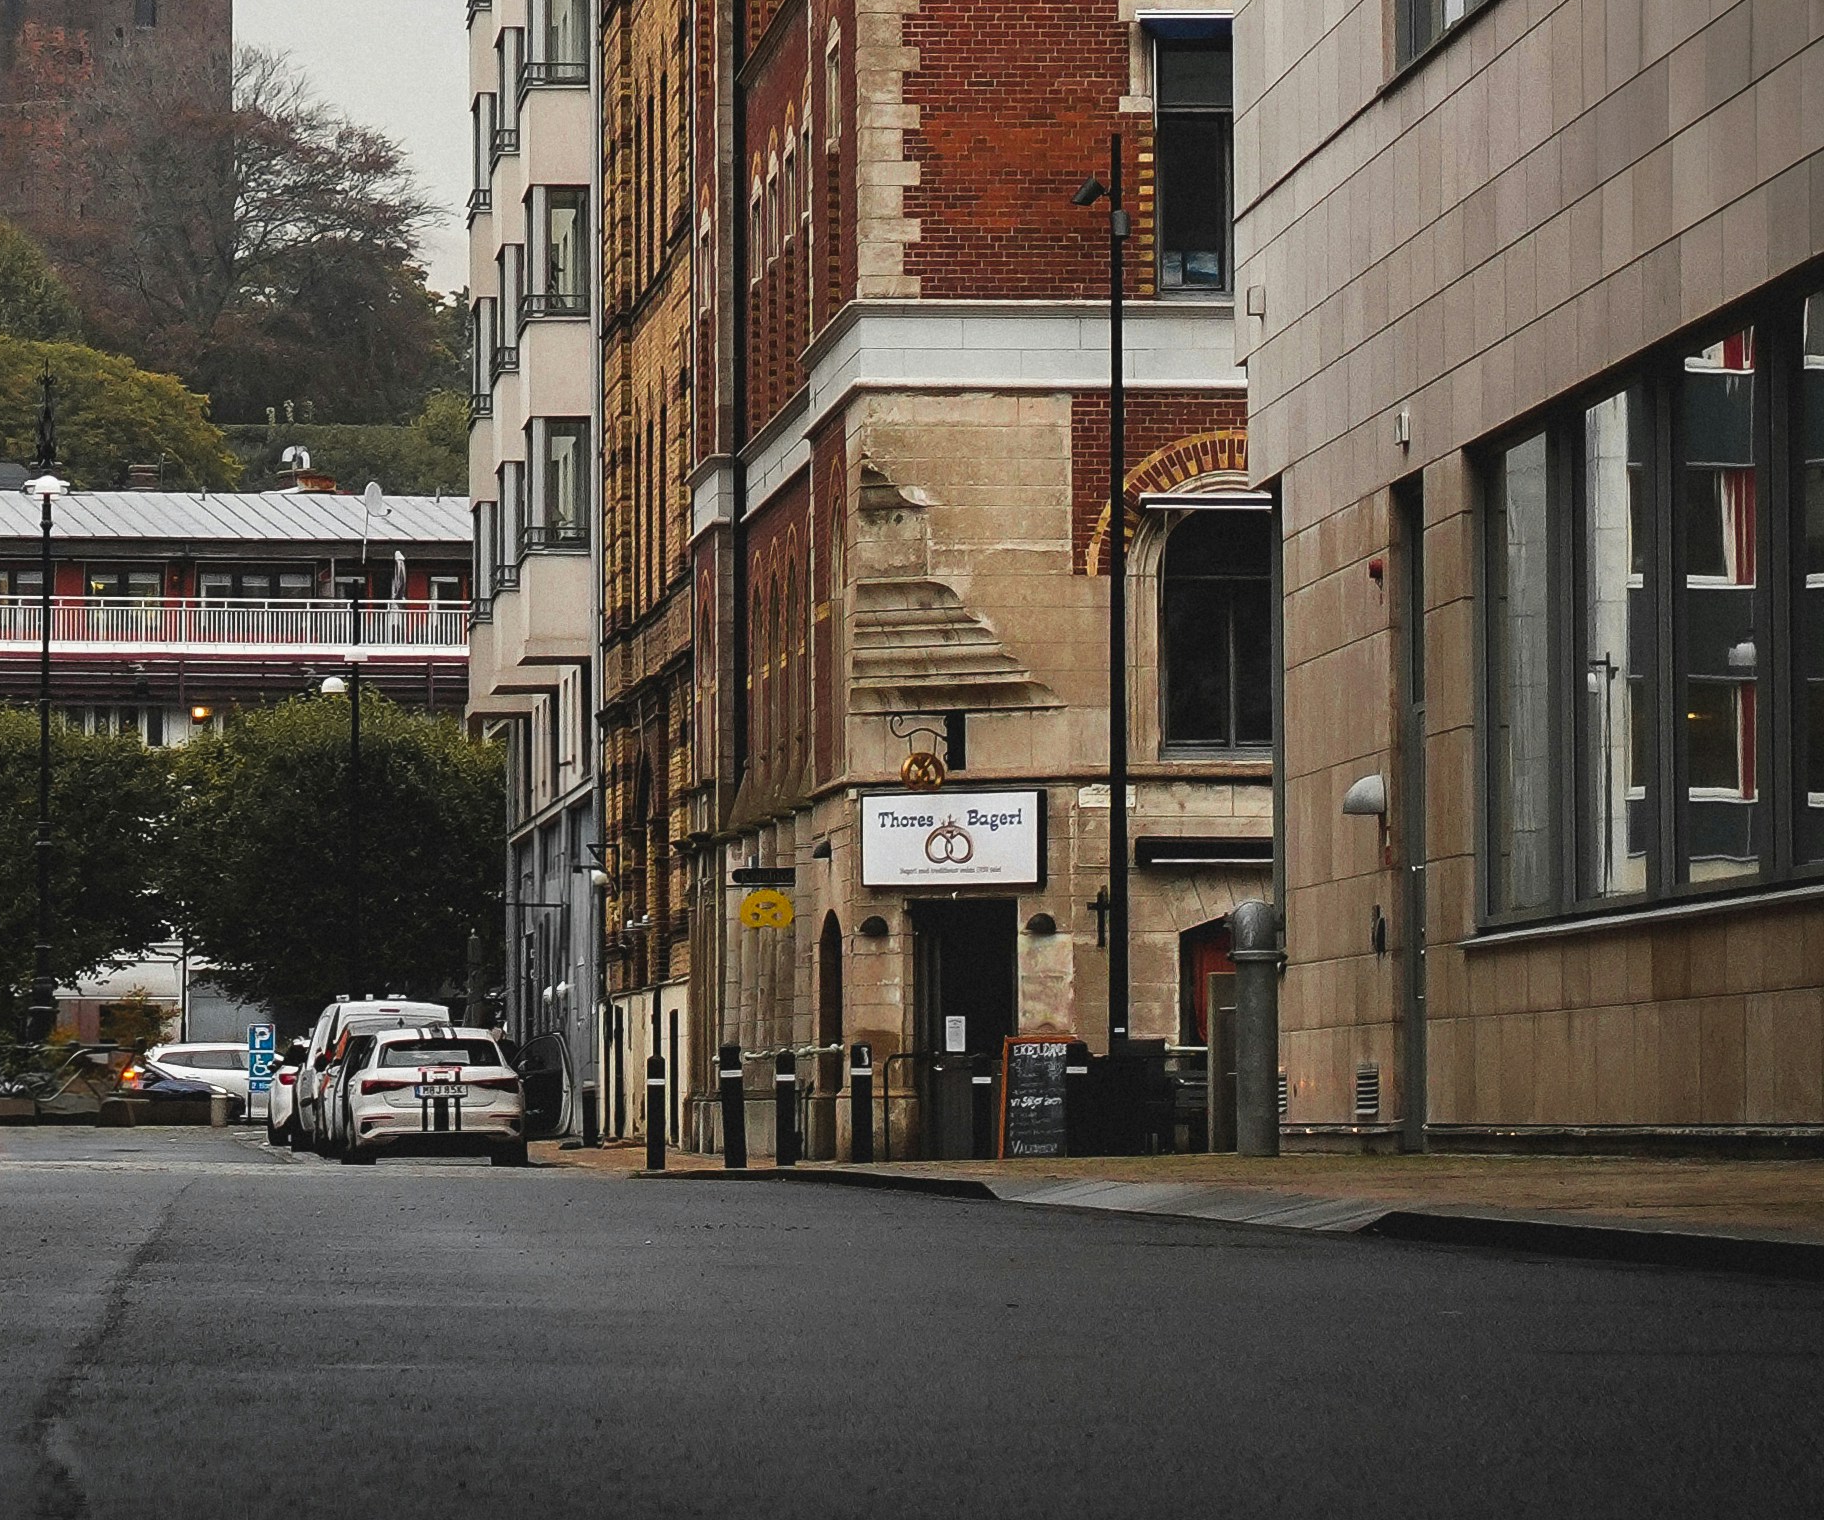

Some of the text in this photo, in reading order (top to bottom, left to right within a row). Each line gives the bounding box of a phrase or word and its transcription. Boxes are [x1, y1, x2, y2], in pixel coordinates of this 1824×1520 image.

[878, 808, 1023, 832] Thores Bageri
[255, 1027, 271, 1049] P
